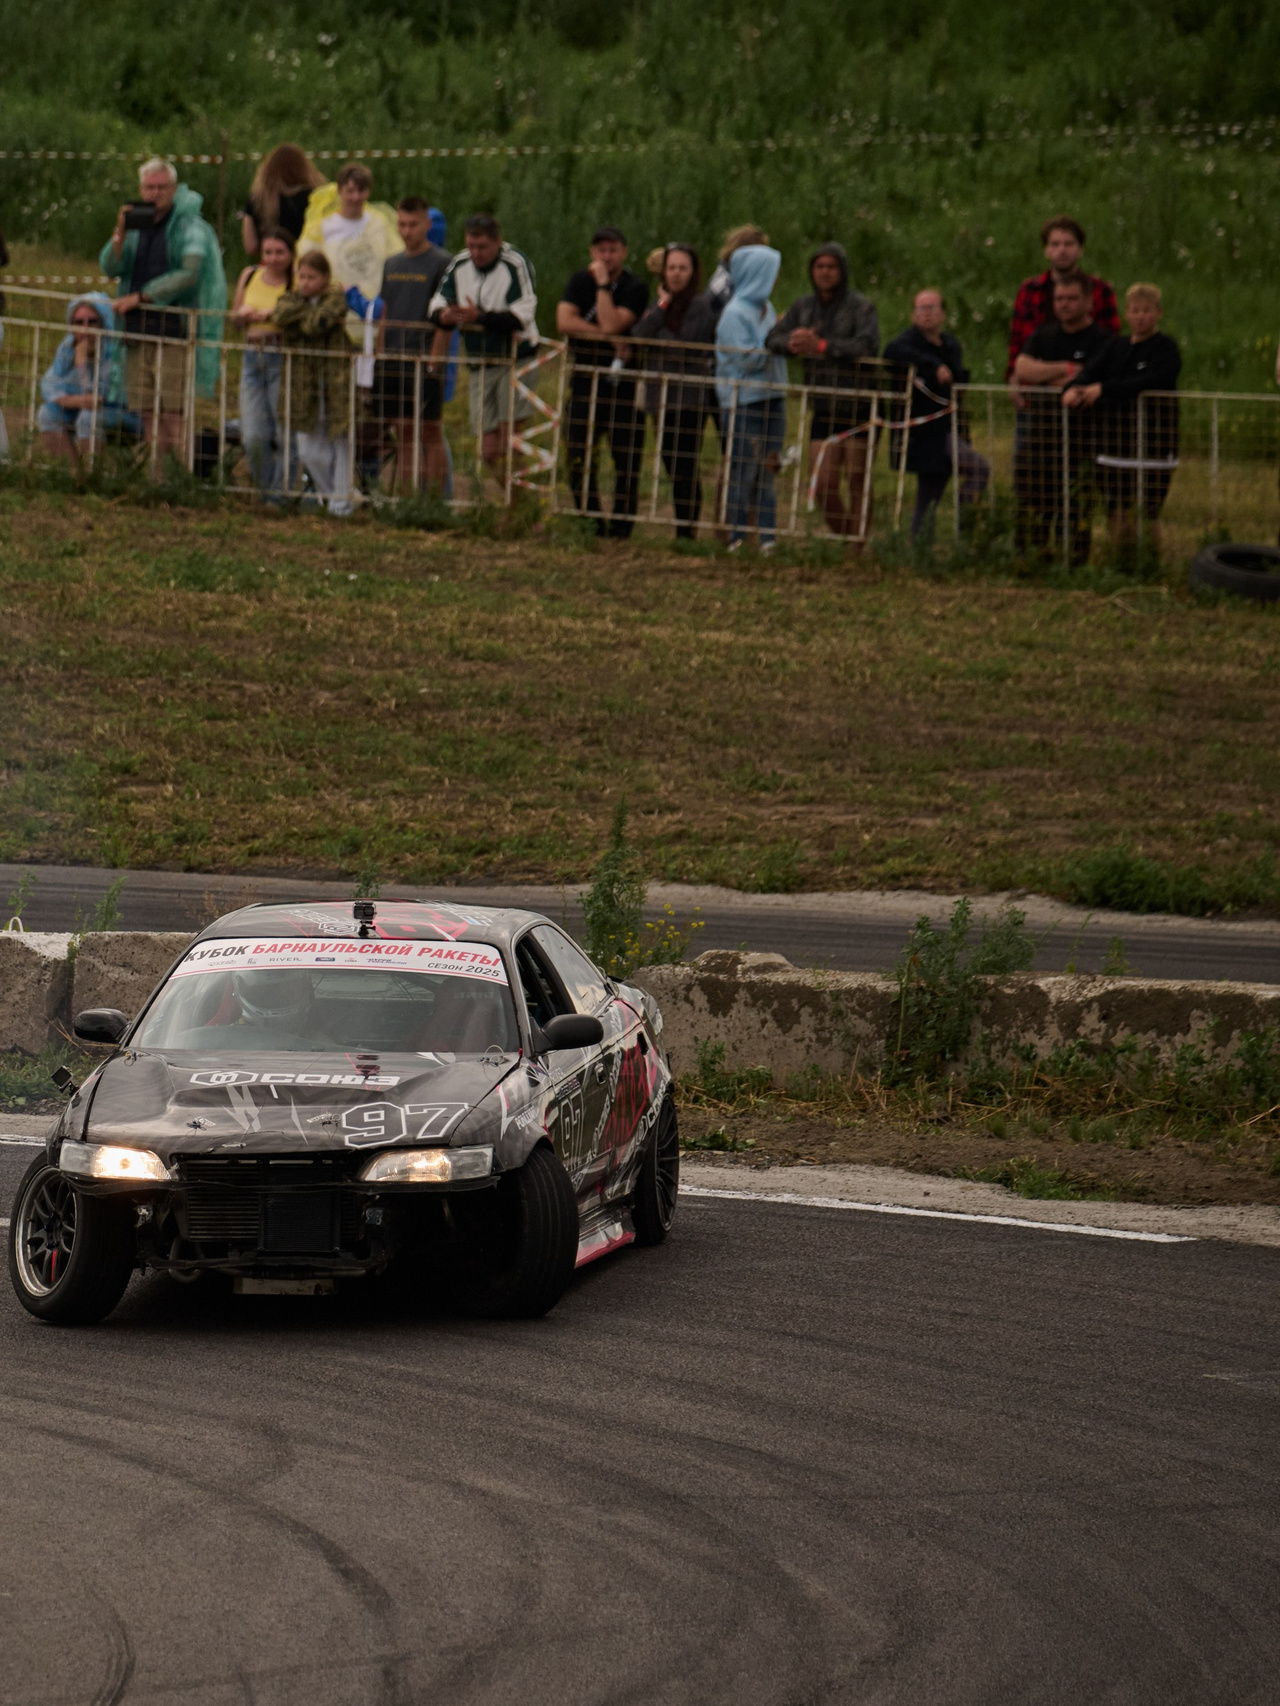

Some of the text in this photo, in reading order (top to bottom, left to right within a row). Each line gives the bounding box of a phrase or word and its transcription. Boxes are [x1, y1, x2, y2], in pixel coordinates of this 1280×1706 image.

[184, 945, 250, 962] КУБОК
[252, 943, 413, 956] БАРНАУЛЬСКОЙ
[417, 947, 501, 967] РАКЕТЫ
[427, 962, 500, 977] СЕЗОН 2025
[260, 1073, 400, 1086] СОЮЗ
[342, 1102, 469, 1148] 97
